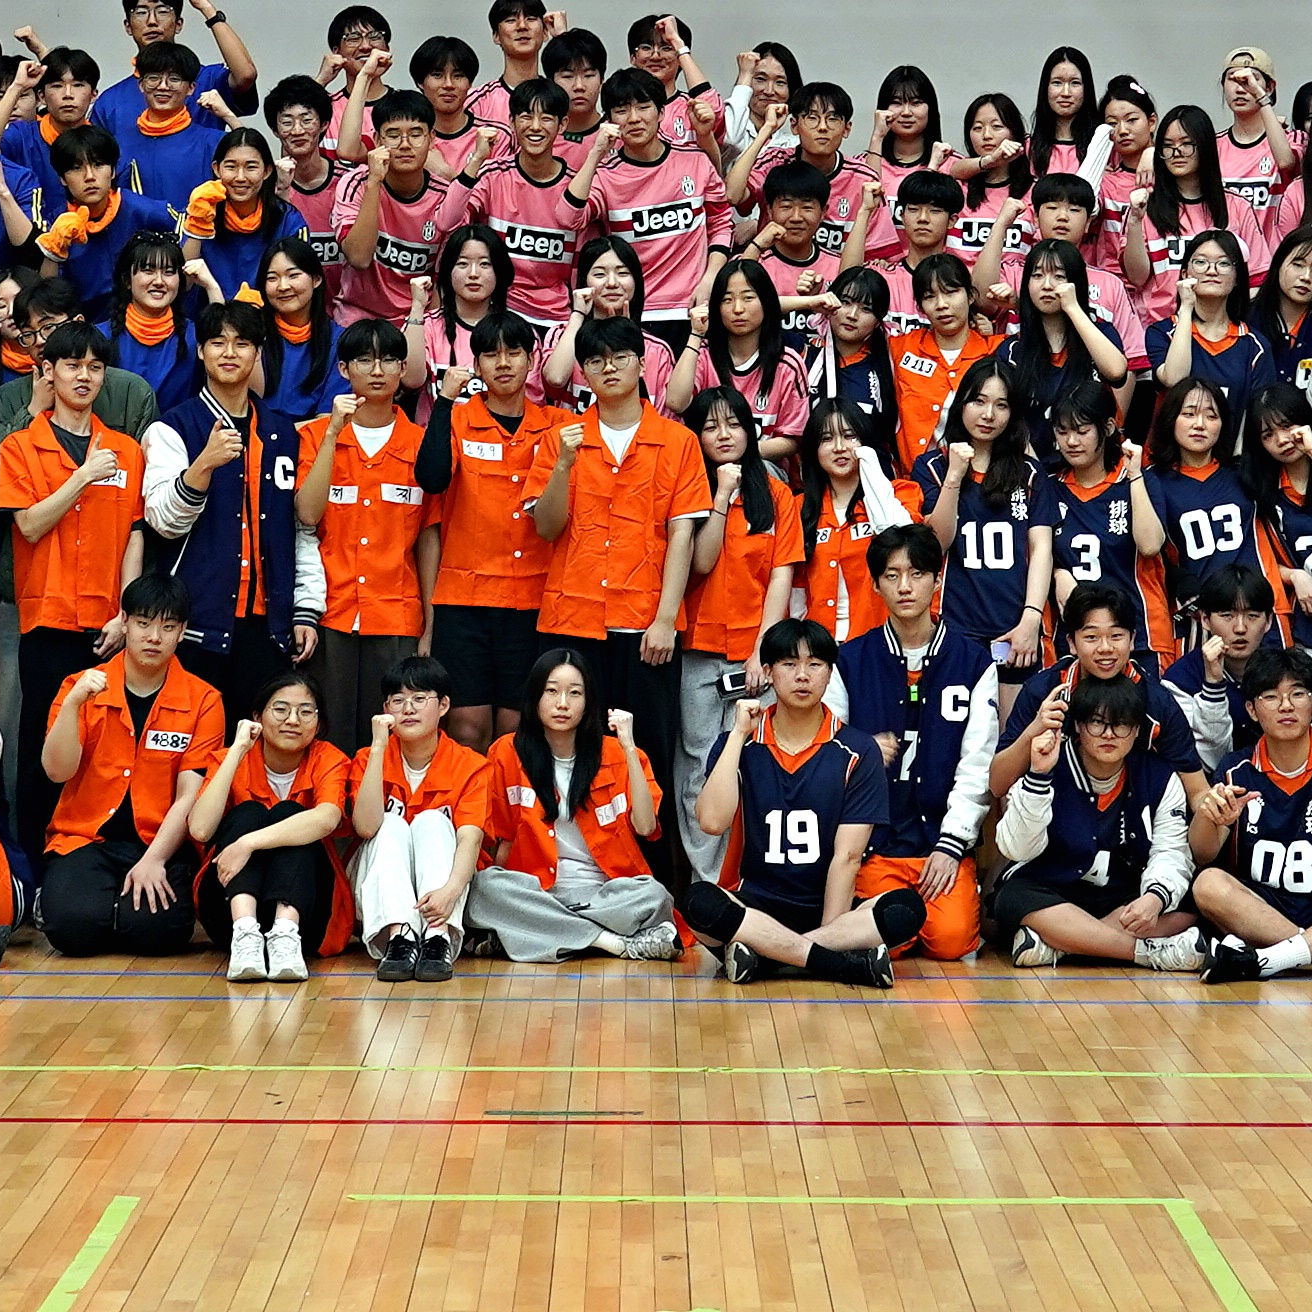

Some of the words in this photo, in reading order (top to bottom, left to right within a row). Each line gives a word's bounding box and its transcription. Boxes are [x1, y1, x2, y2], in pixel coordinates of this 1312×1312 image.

[632, 207, 693, 232] Jeep
[962, 221, 1021, 247] Jep
[505, 226, 564, 258] Jeep
[274, 455, 295, 490] C
[1108, 499, 1129, 536] 排球
[1179, 503, 1244, 561] 03
[961, 521, 1015, 570] 10
[1071, 533, 1101, 582] 3
[940, 684, 970, 722] C
[151, 733, 190, 750] 4885
[764, 809, 821, 865] 19
